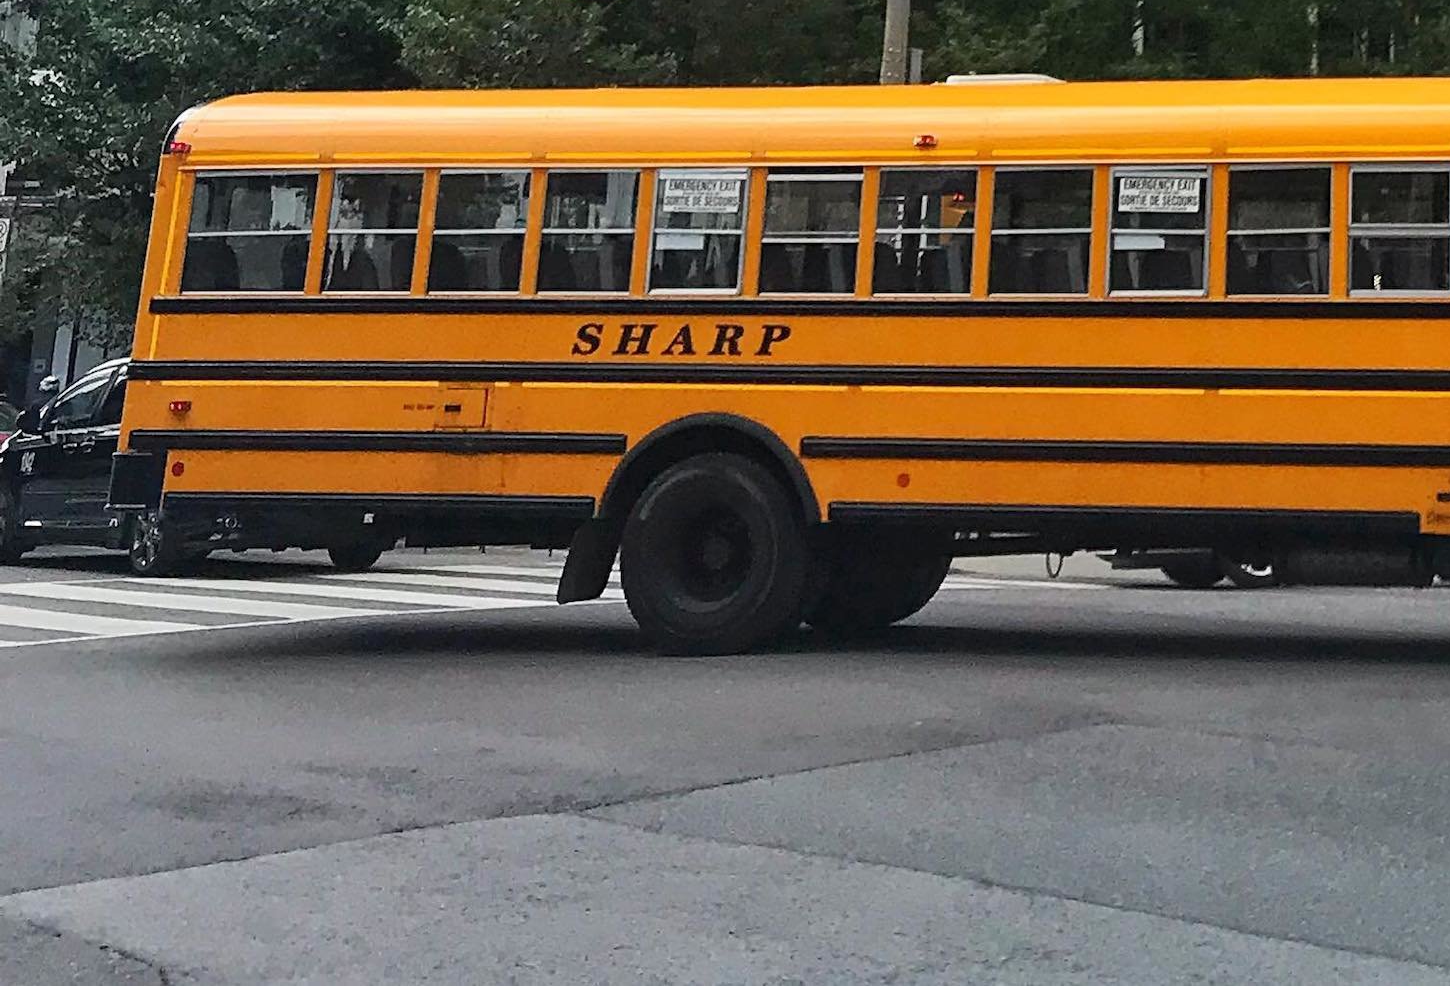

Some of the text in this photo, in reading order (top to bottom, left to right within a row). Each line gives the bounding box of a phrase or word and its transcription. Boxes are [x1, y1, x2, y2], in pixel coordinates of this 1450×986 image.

[669, 180, 738, 192] EMERGENCY EXIT
[1124, 178, 1196, 192] EMERGENCY EXIT
[1120, 194, 1198, 206] SORTIE DE SECOURS
[571, 323, 791, 356] SHARP
